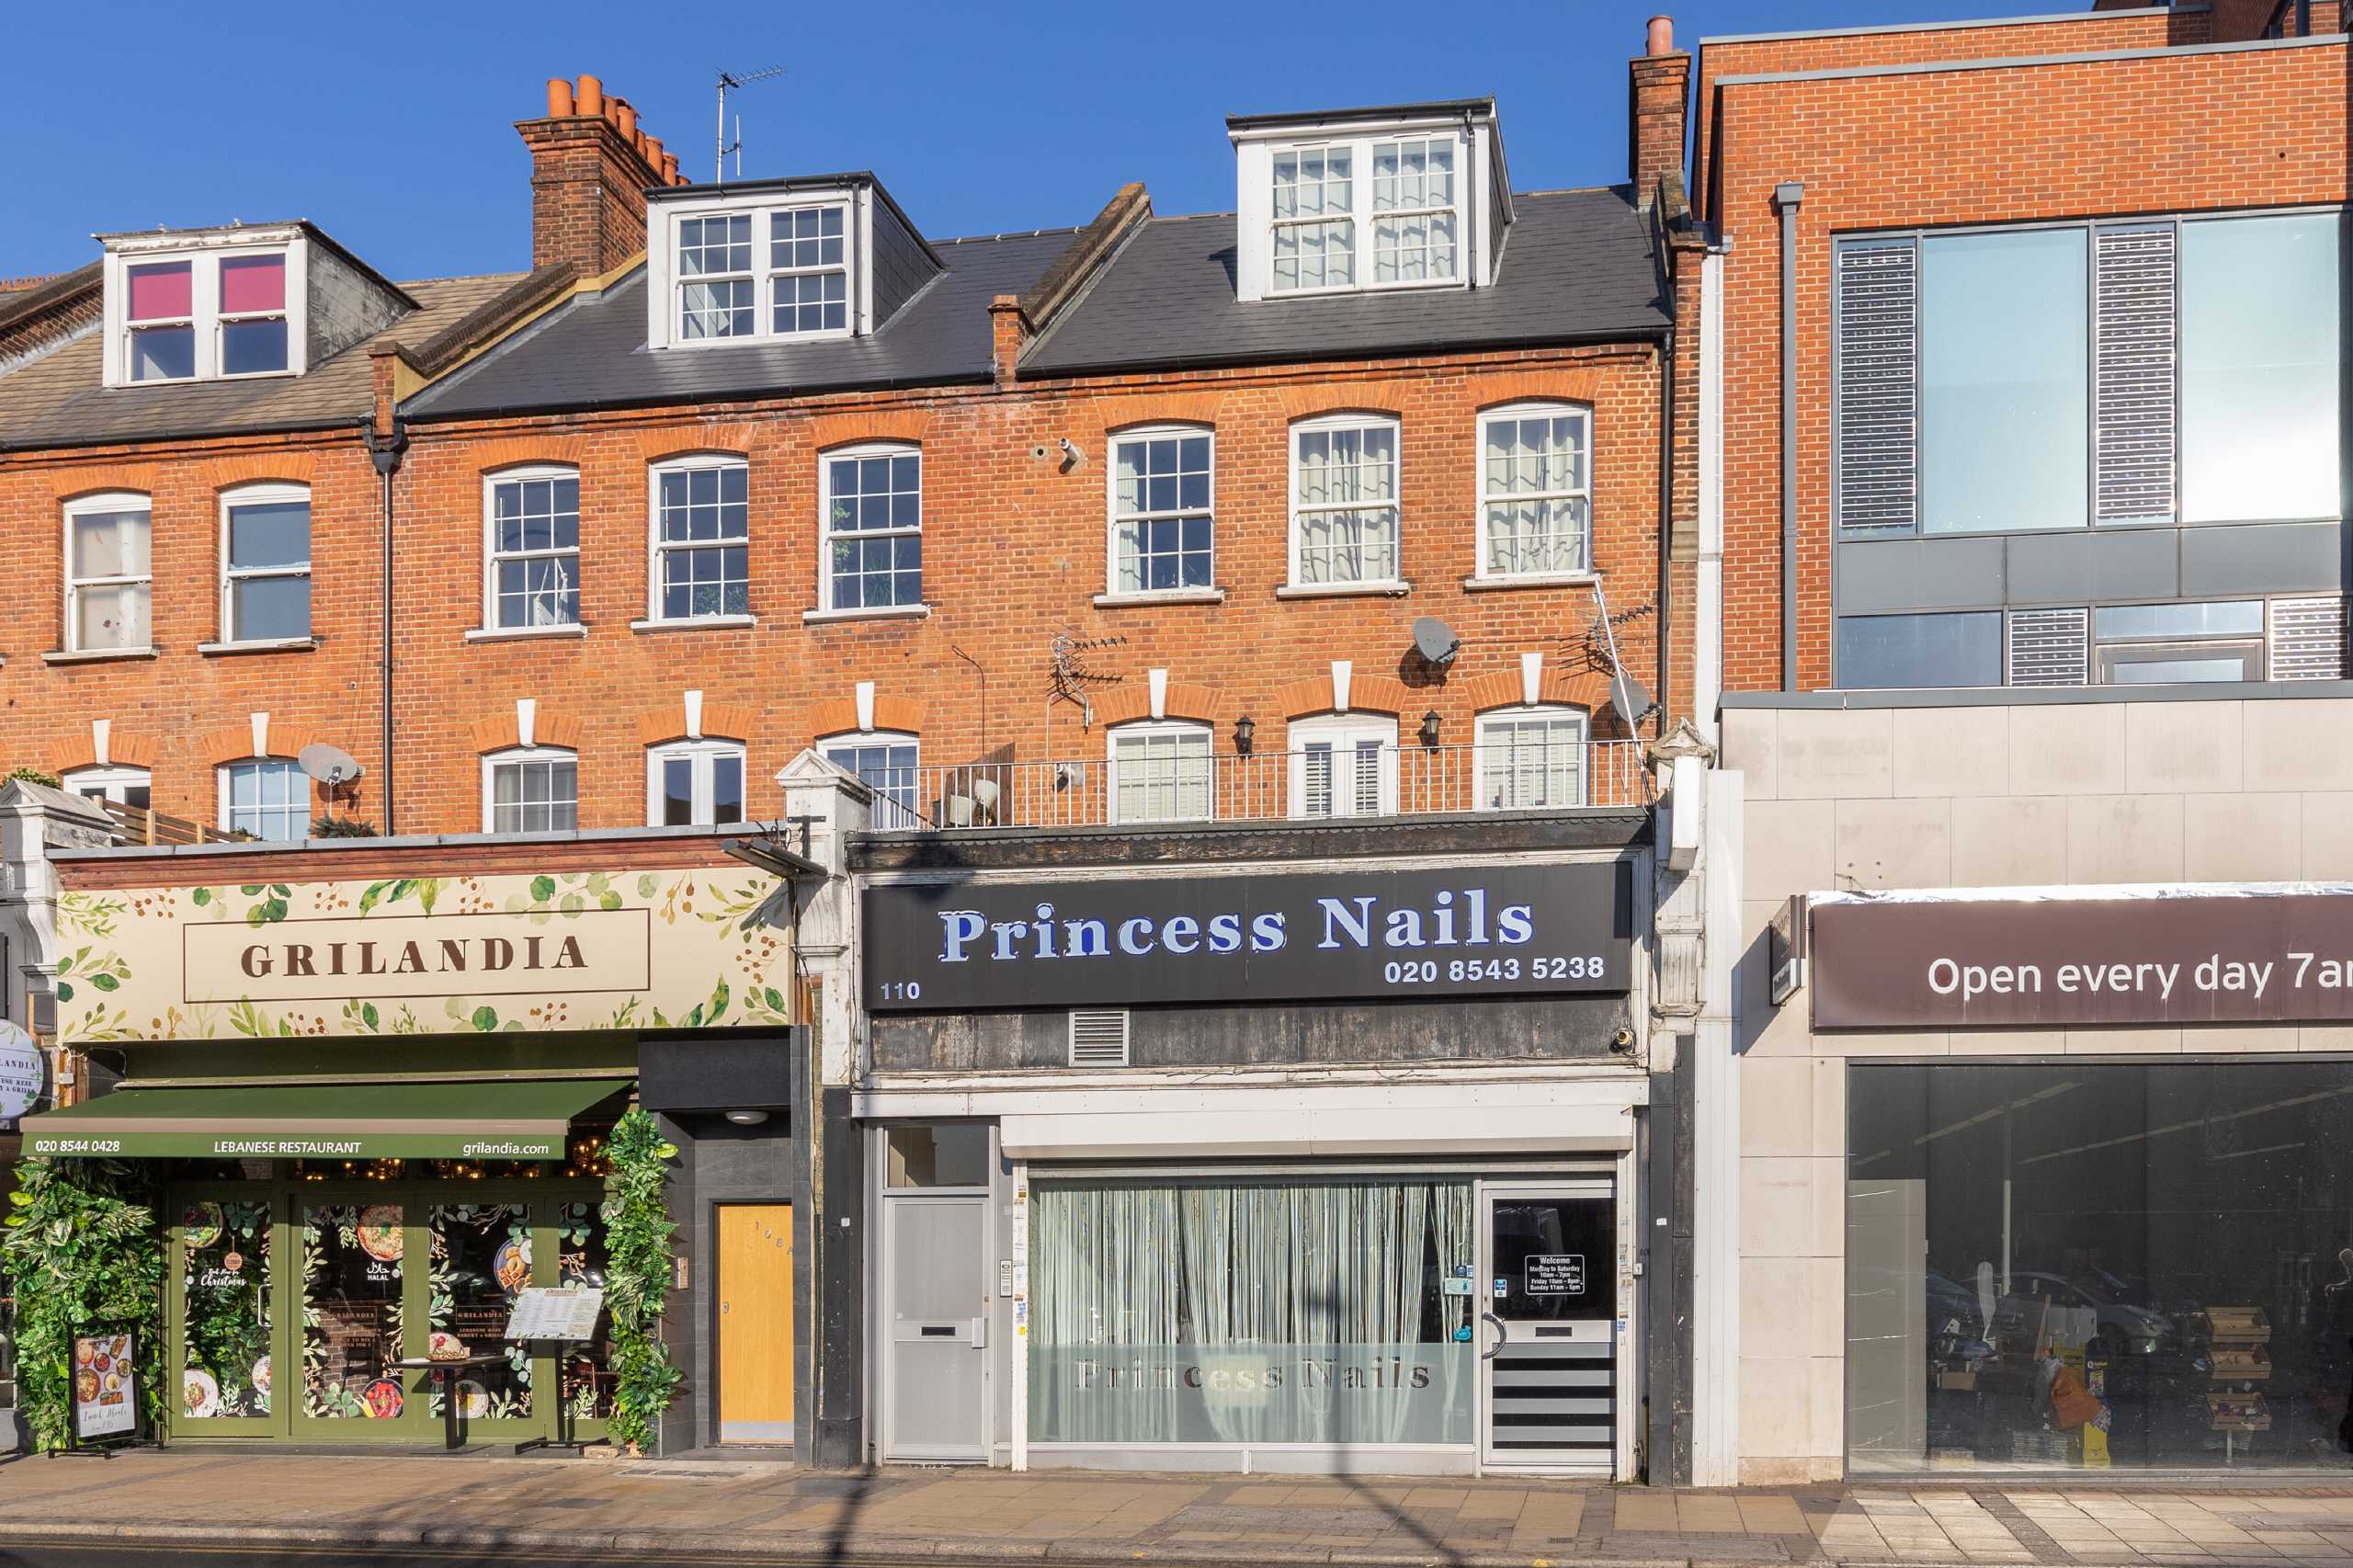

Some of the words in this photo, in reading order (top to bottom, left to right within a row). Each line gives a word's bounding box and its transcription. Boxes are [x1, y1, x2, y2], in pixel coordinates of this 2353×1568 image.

[938, 903, 1287, 962] Princess
[1316, 889, 1534, 950] Nails
[241, 935, 589, 978] GRILANDIA
[1384, 961, 1438, 983] 020
[1449, 959, 1521, 982] 8543
[1531, 957, 1605, 980] 5238
[1927, 958, 2041, 1001] Open
[2056, 962, 2180, 999] every
[2194, 954, 2274, 998] day
[880, 982, 920, 1000] 110
[35, 1141, 57, 1153] 020
[60, 1141, 88, 1153] 8544
[91, 1141, 120, 1153] 0428
[214, 1142, 276, 1153] LEBANESE
[278, 1142, 362, 1153] RESTAURANT
[462, 1142, 549, 1156] grilandia.com
[200, 1274, 247, 1287] Christmas
[1074, 1356, 1283, 1391] Princess
[1302, 1356, 1431, 1390] Nails
